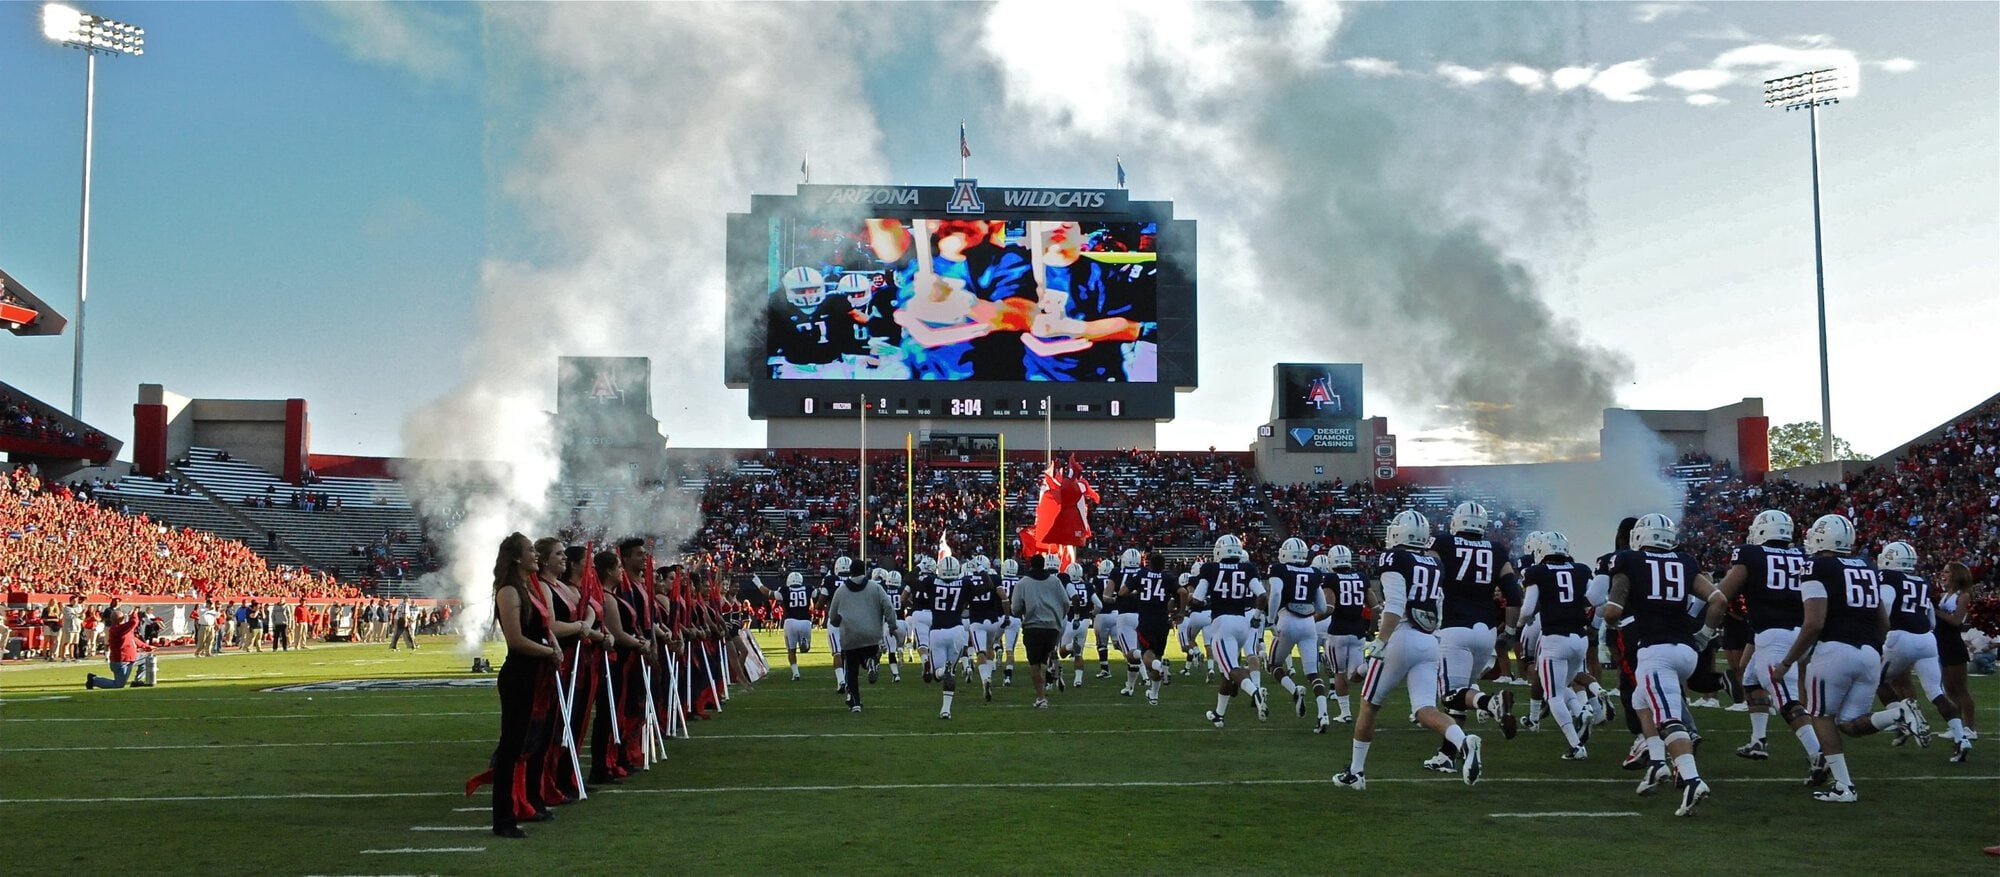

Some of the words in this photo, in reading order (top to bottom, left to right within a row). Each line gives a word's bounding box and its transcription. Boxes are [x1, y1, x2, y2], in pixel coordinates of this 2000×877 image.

[827, 188, 919, 205] ARIZONA
[946, 178, 985, 214] A
[1004, 190, 1106, 208] WILDCATS
[804, 397, 814, 414] 0
[880, 398, 887, 409] 3
[951, 398, 982, 416] 3:04
[1022, 399, 1027, 410] 1
[1040, 399, 1047, 410] 3
[1110, 400, 1120, 417] 0
[1313, 434, 1355, 442] DIAMOND
[960, 455, 969, 463] 12
[1314, 466, 1323, 474] 14
[1379, 552, 1395, 567] 84
[1456, 548, 1493, 584] 79
[1140, 578, 1166, 602] 34
[1213, 570, 1246, 599] 46
[1295, 574, 1309, 601] 6
[1408, 565, 1441, 602] 84
[1556, 571, 1575, 603] 9
[1645, 560, 1685, 602] 19
[1844, 568, 1880, 609] 63
[789, 590, 808, 608] 99
[934, 586, 962, 611] 27
[1339, 580, 1365, 606] 85
[1901, 580, 1930, 614] 24
